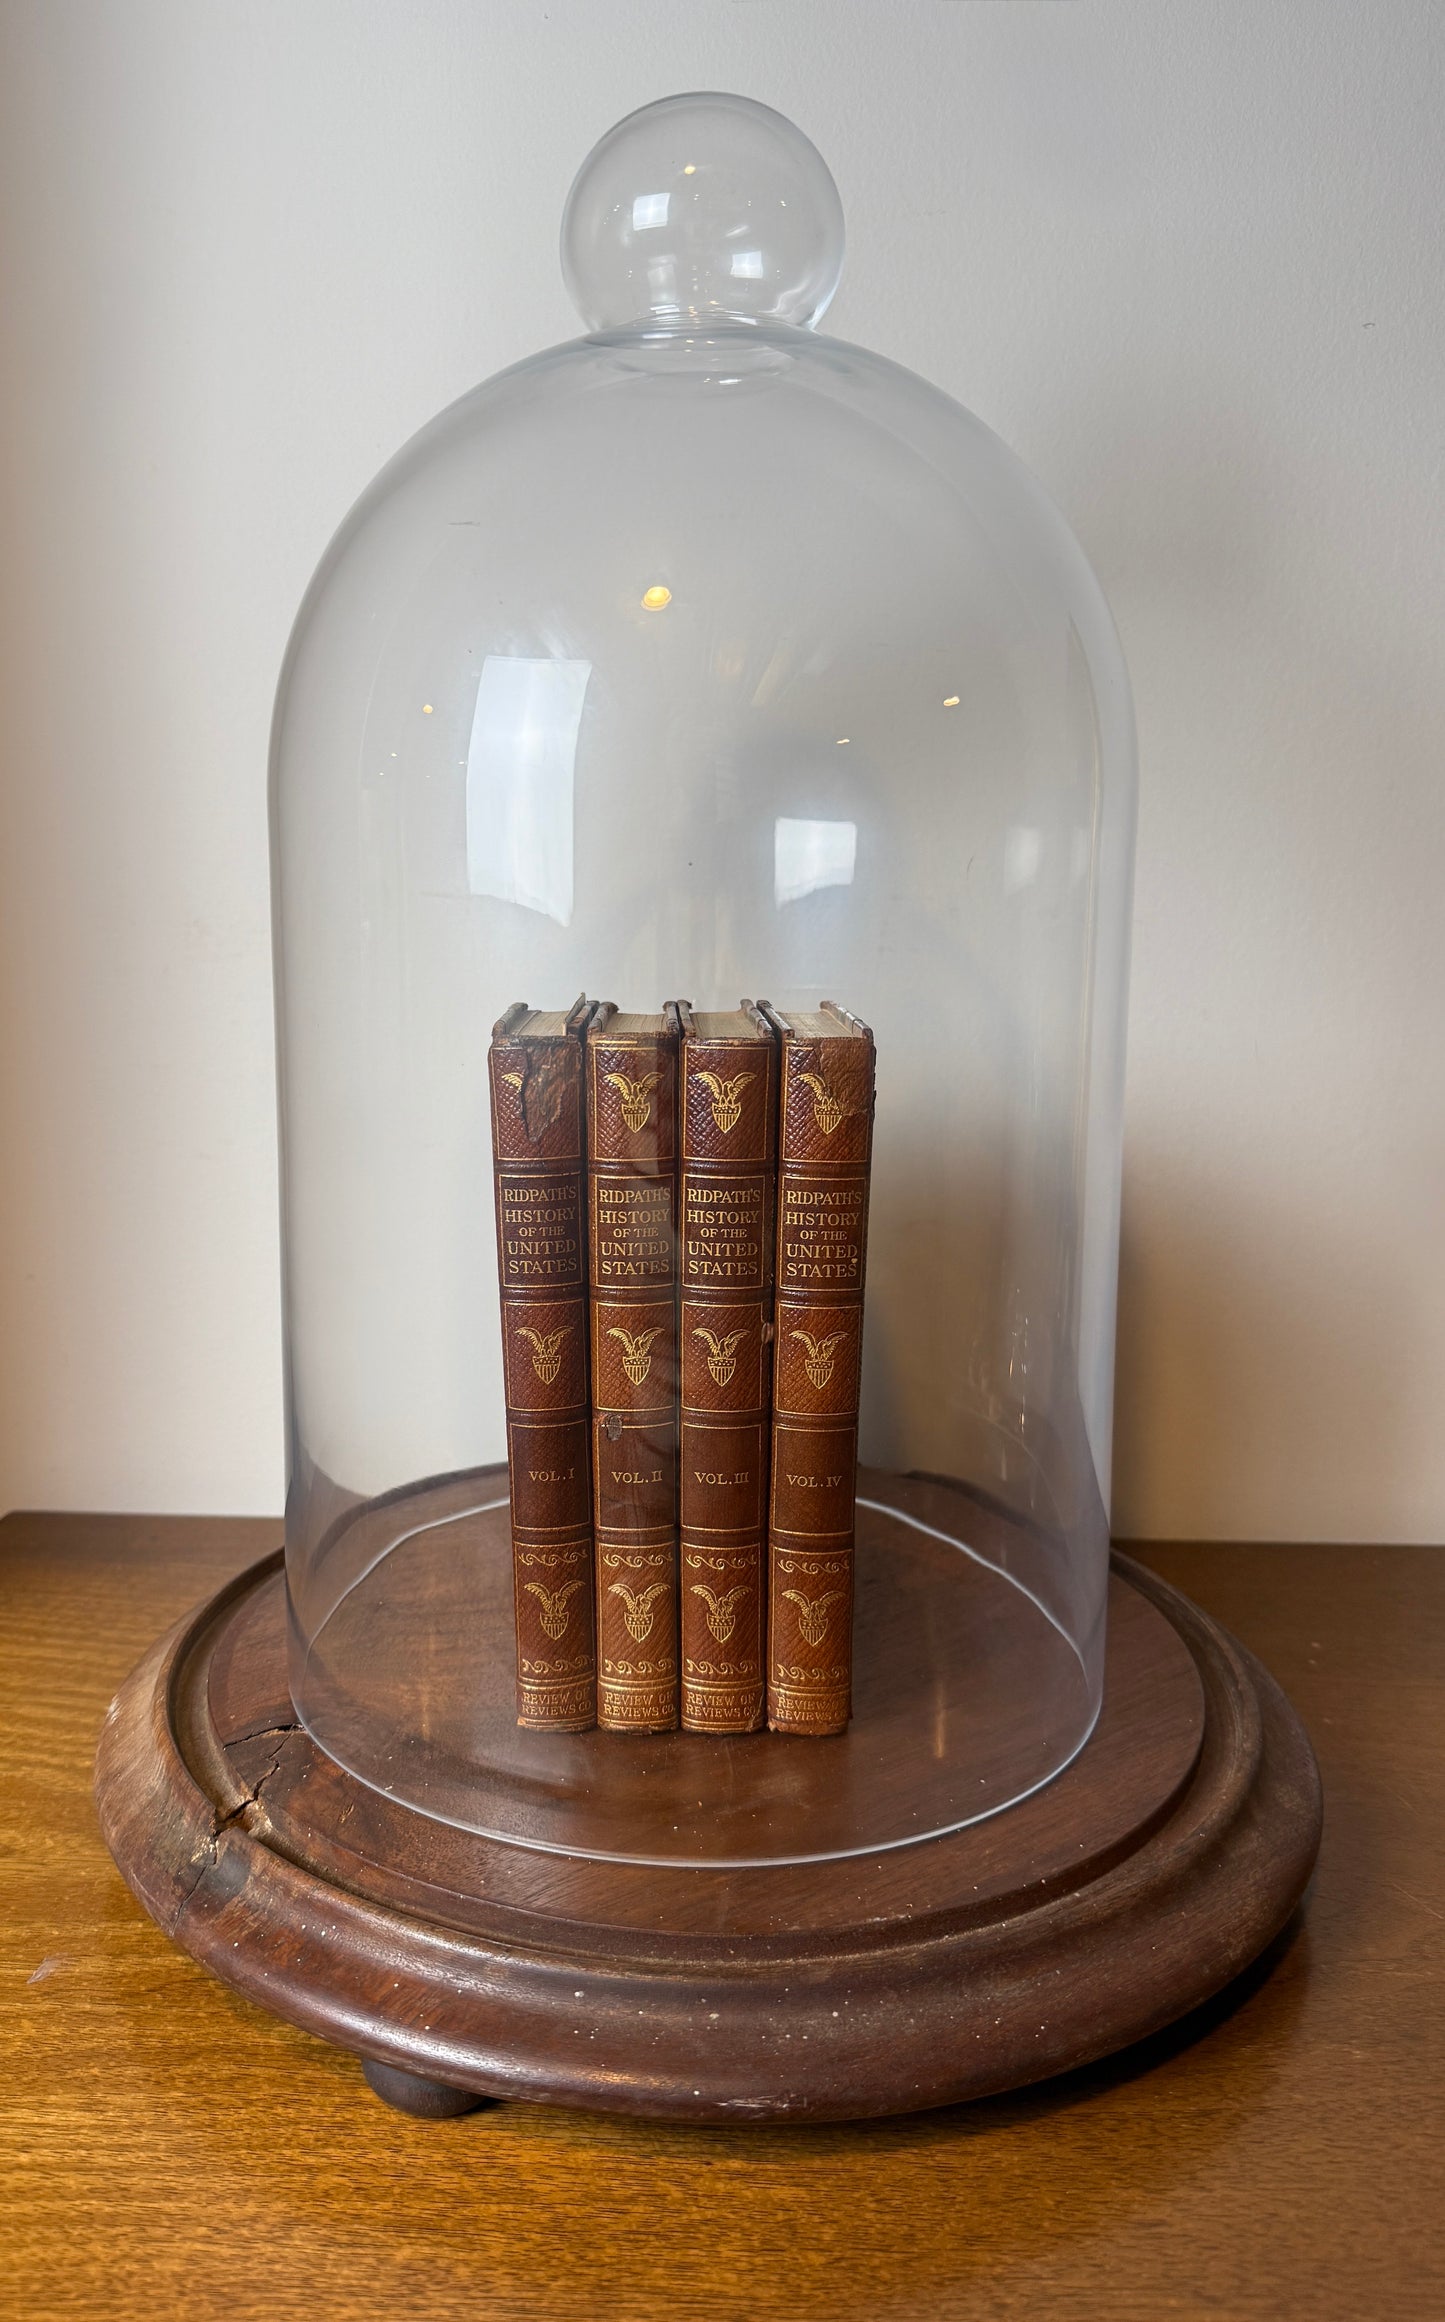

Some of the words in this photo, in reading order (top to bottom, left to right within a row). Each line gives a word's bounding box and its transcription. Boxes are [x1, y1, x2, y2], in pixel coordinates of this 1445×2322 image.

[504, 1185, 576, 1202] RIDPATH'S
[599, 1187, 670, 1203] RIDPATH'S
[687, 1188, 761, 1203] RIDPATH'S
[786, 1190, 862, 1205] RIDPATH'S
[505, 1208, 575, 1222] HISTORY
[600, 1208, 670, 1224] HISTORY
[687, 1210, 759, 1224] HISTORY
[787, 1212, 859, 1226] HISTORY
[519, 1228, 536, 1238] OF
[539, 1226, 565, 1236] THE
[613, 1228, 631, 1238] OF
[635, 1227, 658, 1238] THE
[700, 1228, 718, 1238] OF
[722, 1228, 747, 1238] THE
[800, 1230, 817, 1240] OF
[821, 1230, 847, 1240] THE
[508, 1239, 576, 1255] UNITED
[601, 1241, 669, 1256] UNITED
[688, 1242, 758, 1256] UNITED
[786, 1244, 857, 1259] UNITED
[509, 1258, 577, 1274] STATES
[602, 1260, 669, 1275] STATES
[688, 1260, 758, 1275] STATES
[787, 1262, 857, 1277] STATES
[523, 1692, 569, 1704] REVIEW
[606, 1692, 653, 1706] REVIEW
[688, 1692, 735, 1706] REVIEW
[522, 1704, 576, 1716] REVIEWS
[604, 1704, 659, 1717] REVIEWS
[686, 1704, 740, 1717] REVIEWS
